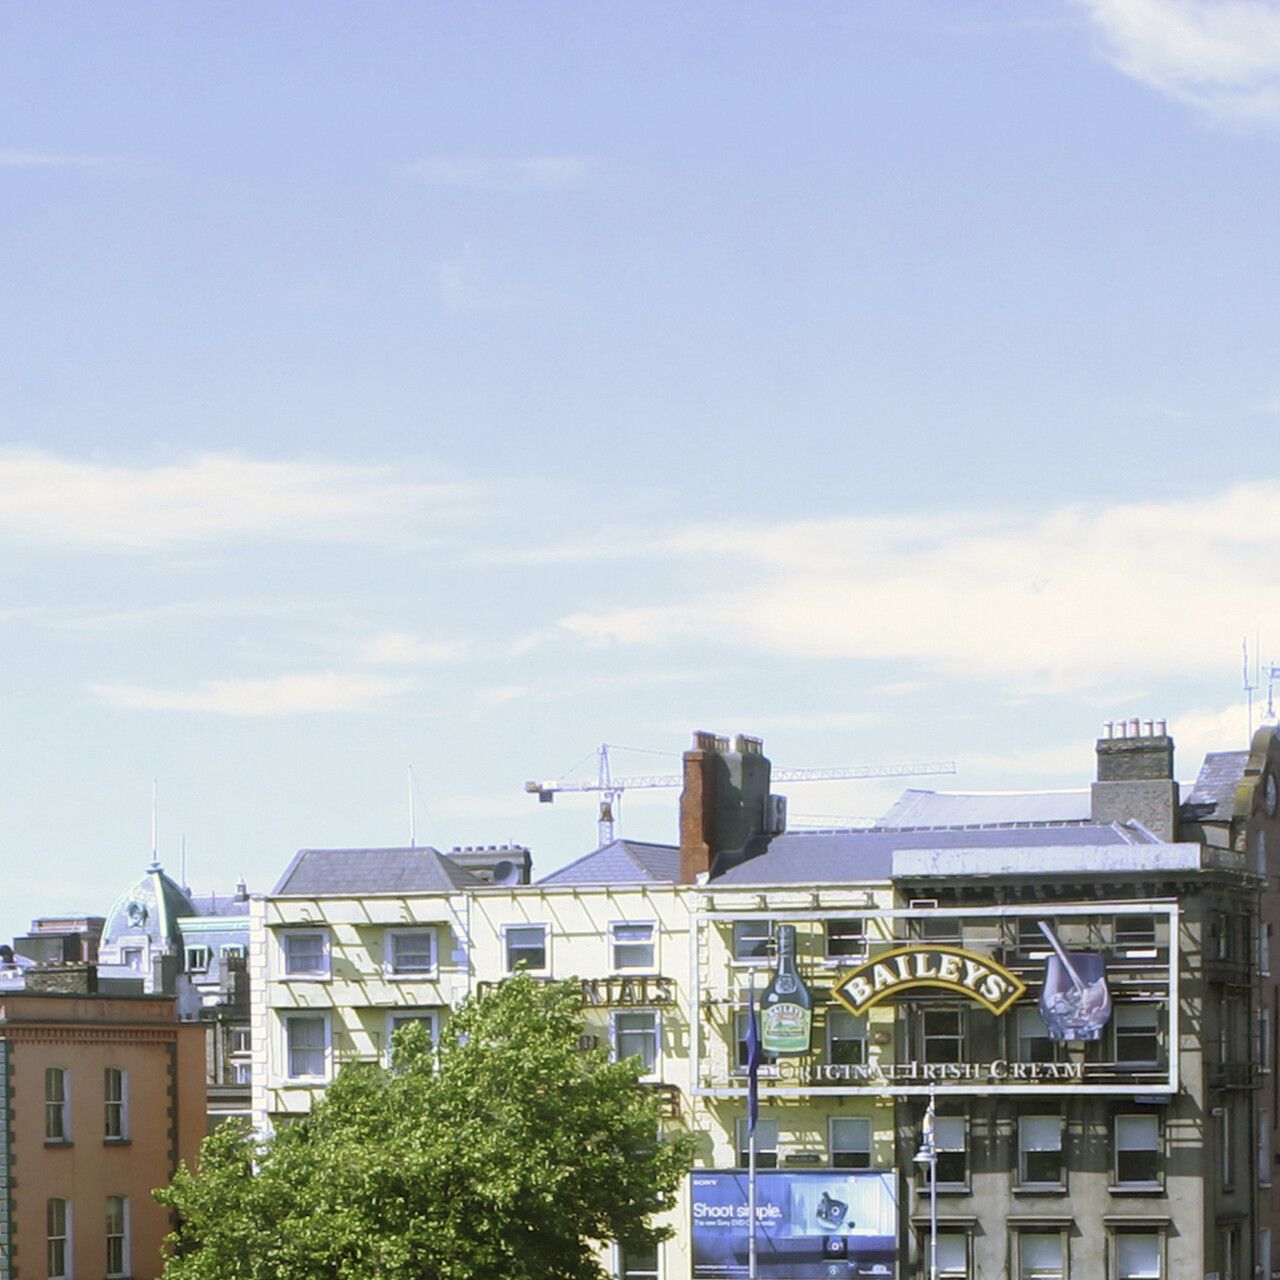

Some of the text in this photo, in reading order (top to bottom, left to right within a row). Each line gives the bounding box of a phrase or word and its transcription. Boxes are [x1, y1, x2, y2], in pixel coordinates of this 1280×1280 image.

[844, 953, 1006, 1005] BAILEYS
[911, 1060, 980, 1080] IRISH
[990, 1059, 1084, 1080] CREAM
[693, 1202, 735, 1218] Shoot
